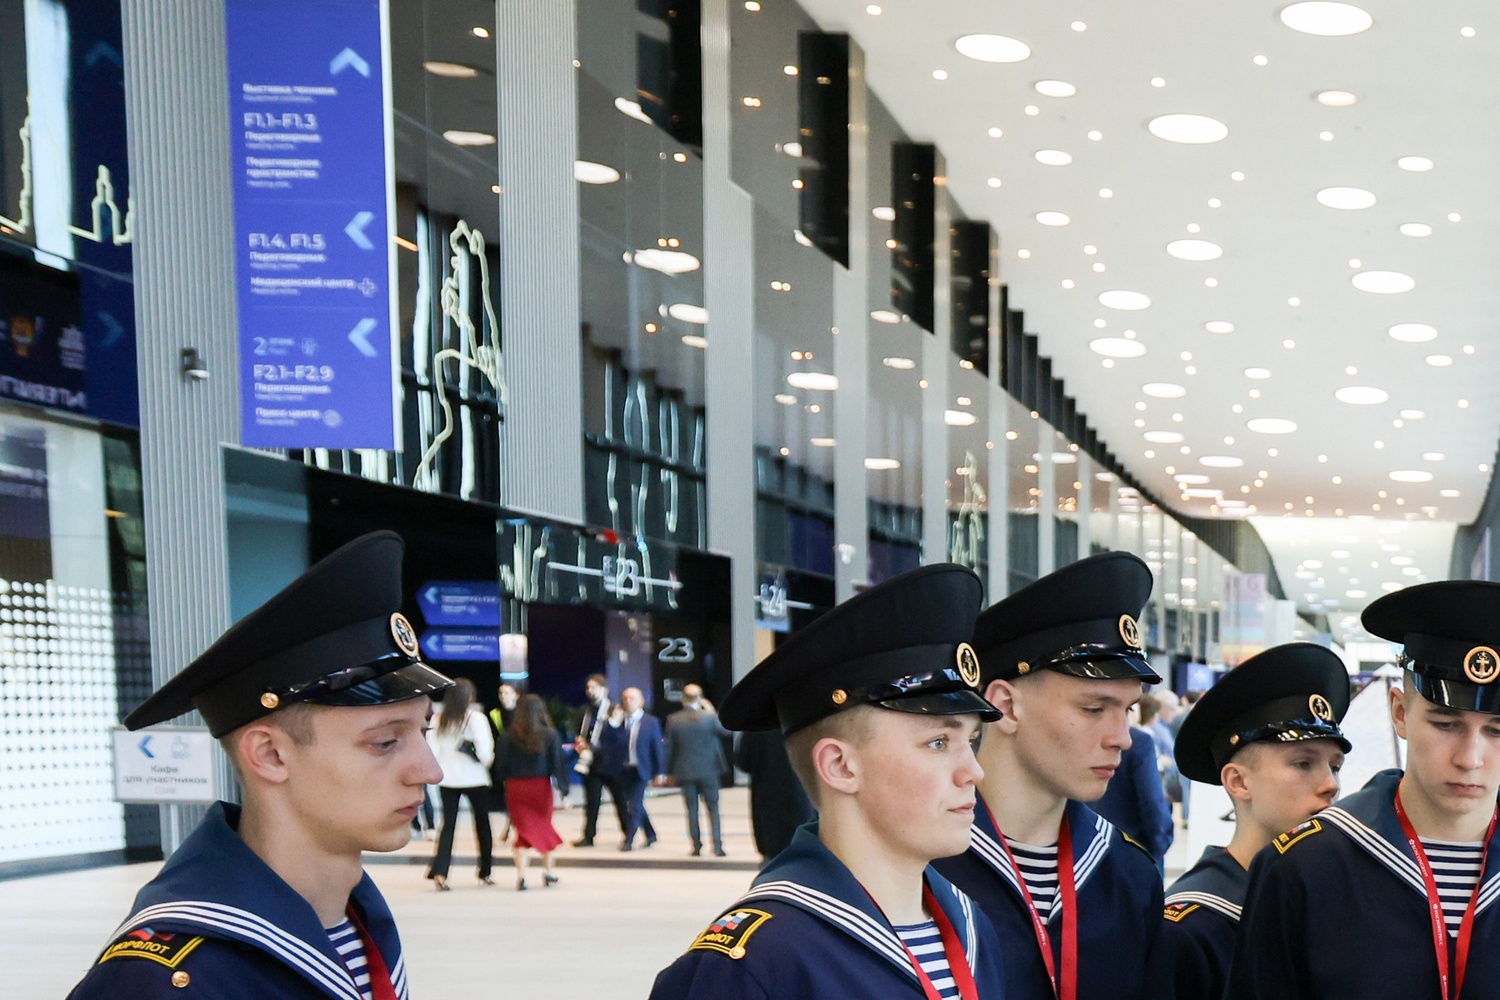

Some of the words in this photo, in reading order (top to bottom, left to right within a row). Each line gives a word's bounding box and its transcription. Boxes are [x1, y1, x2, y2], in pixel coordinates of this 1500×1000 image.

[290, 233, 326, 250] F1.5
[253, 336, 268, 356] 2
[658, 637, 695, 663] 23
[150, 764, 179, 774] Кафе
[122, 775, 143, 784] для
[146, 776, 208, 784] участников
